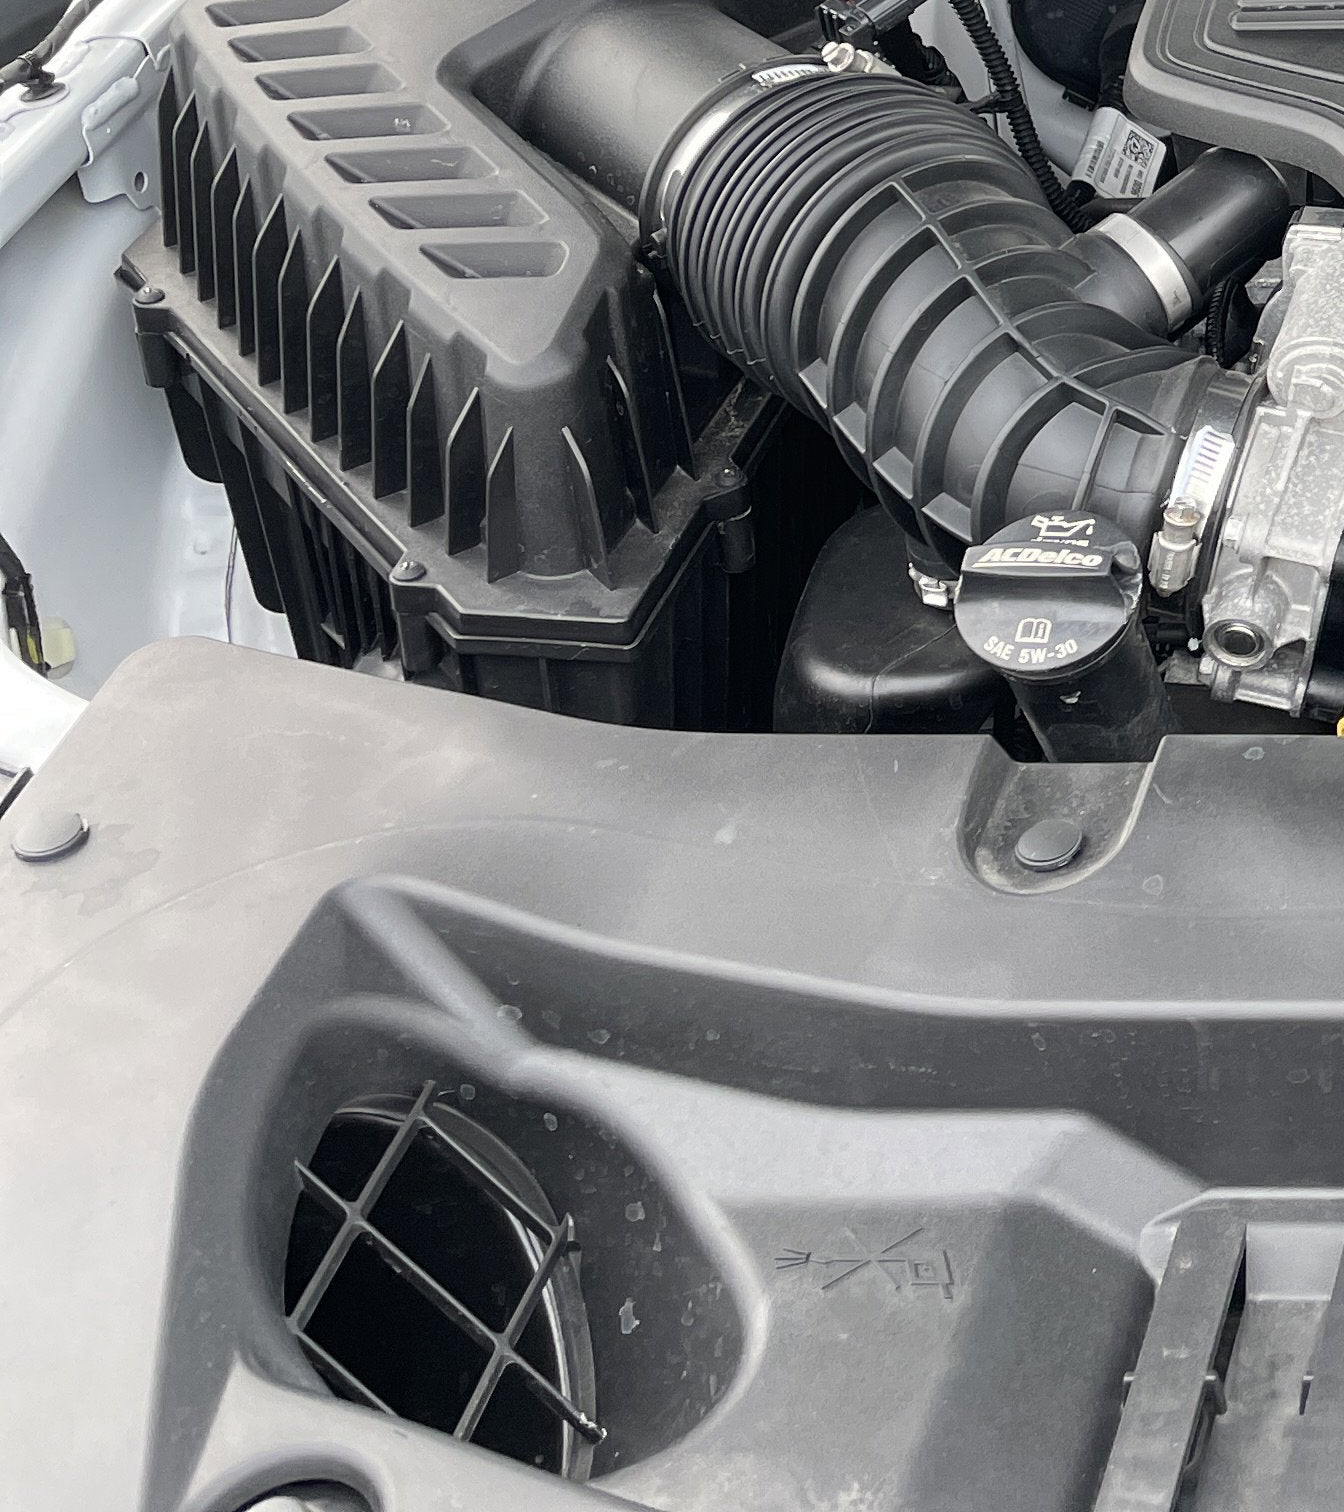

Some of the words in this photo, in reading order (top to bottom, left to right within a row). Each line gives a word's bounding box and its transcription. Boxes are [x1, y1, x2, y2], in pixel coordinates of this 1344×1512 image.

[978, 547, 1103, 568] ACDelco
[983, 635, 1015, 661] SAE
[1018, 639, 1079, 664] 5W-30
